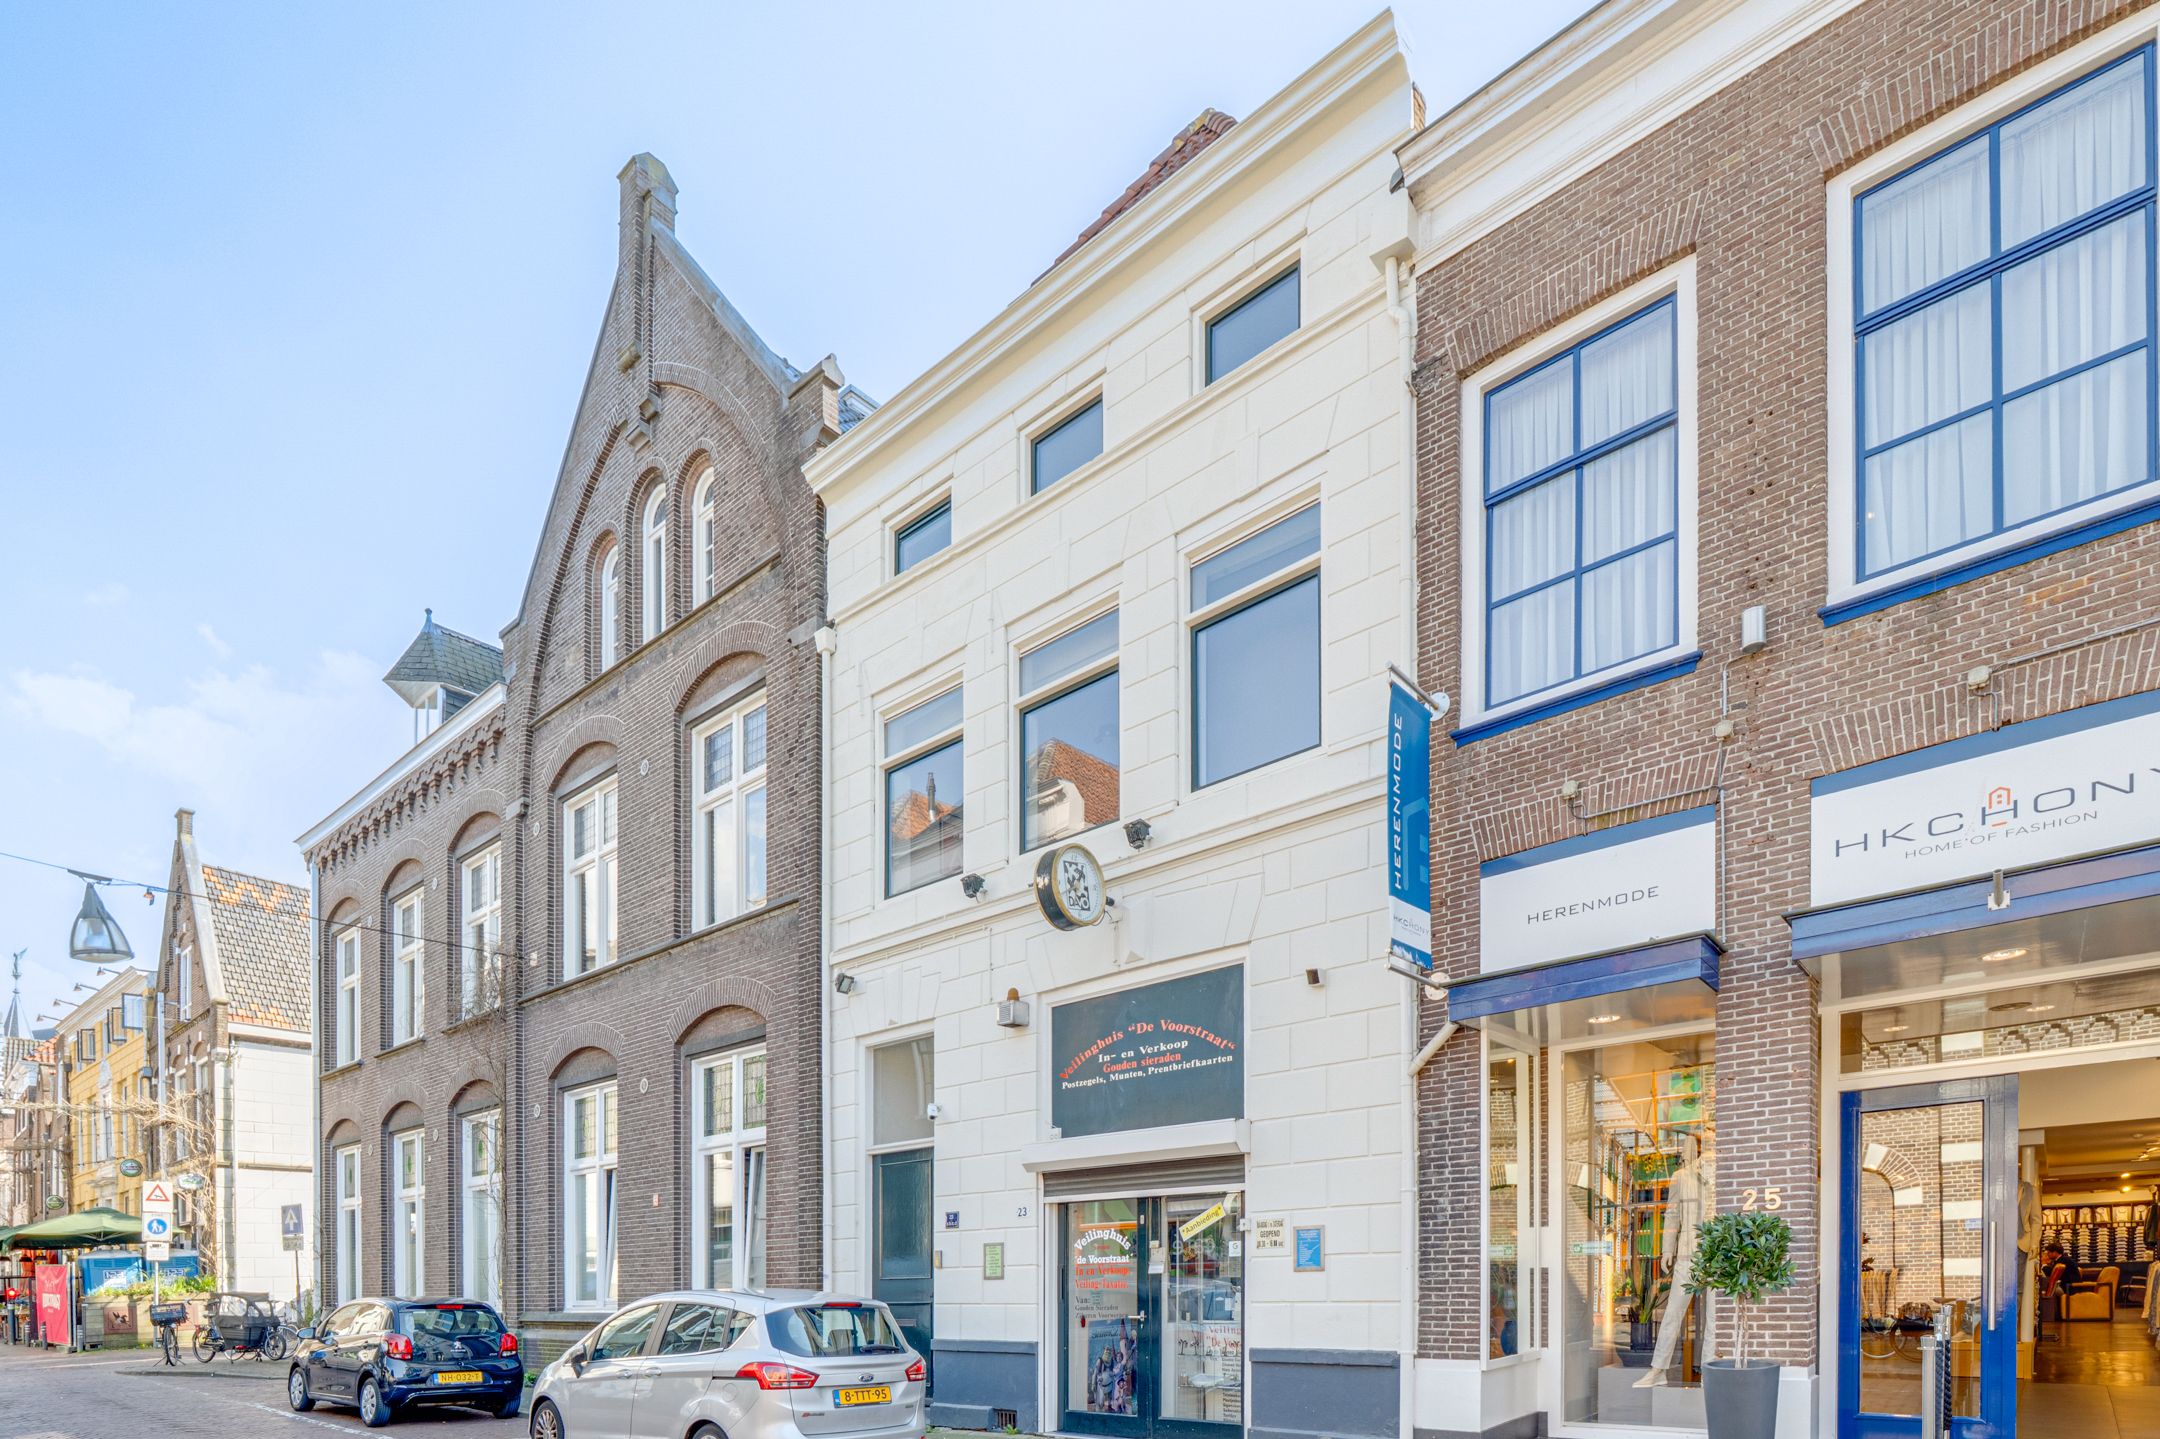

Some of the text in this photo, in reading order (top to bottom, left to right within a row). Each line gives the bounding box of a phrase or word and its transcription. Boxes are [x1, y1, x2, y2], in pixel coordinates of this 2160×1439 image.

[1393, 713, 1403, 889] HERENMODE
[1835, 767, 2160, 858] HKCHON
[1905, 810, 2098, 859] HOME OF FASHION
[1527, 885, 1659, 925] HERENMODE
[1059, 1030, 1124, 1079] Veilinghuis
[1098, 1039, 1189, 1063] In- en Verkoop
[1103, 1052, 1181, 1073] Gouden sieraden
[1061, 1054, 1233, 1089] Postzegels, Munten, Prentbriefkaarten
[1742, 1187, 1782, 1211] 25
[1017, 1207, 1028, 1217] 23
[1074, 1228, 1131, 1250] Veilinghuis
[441, 1373, 479, 1382] NH-032-T
[844, 1388, 887, 1403] 8-TTT-95
